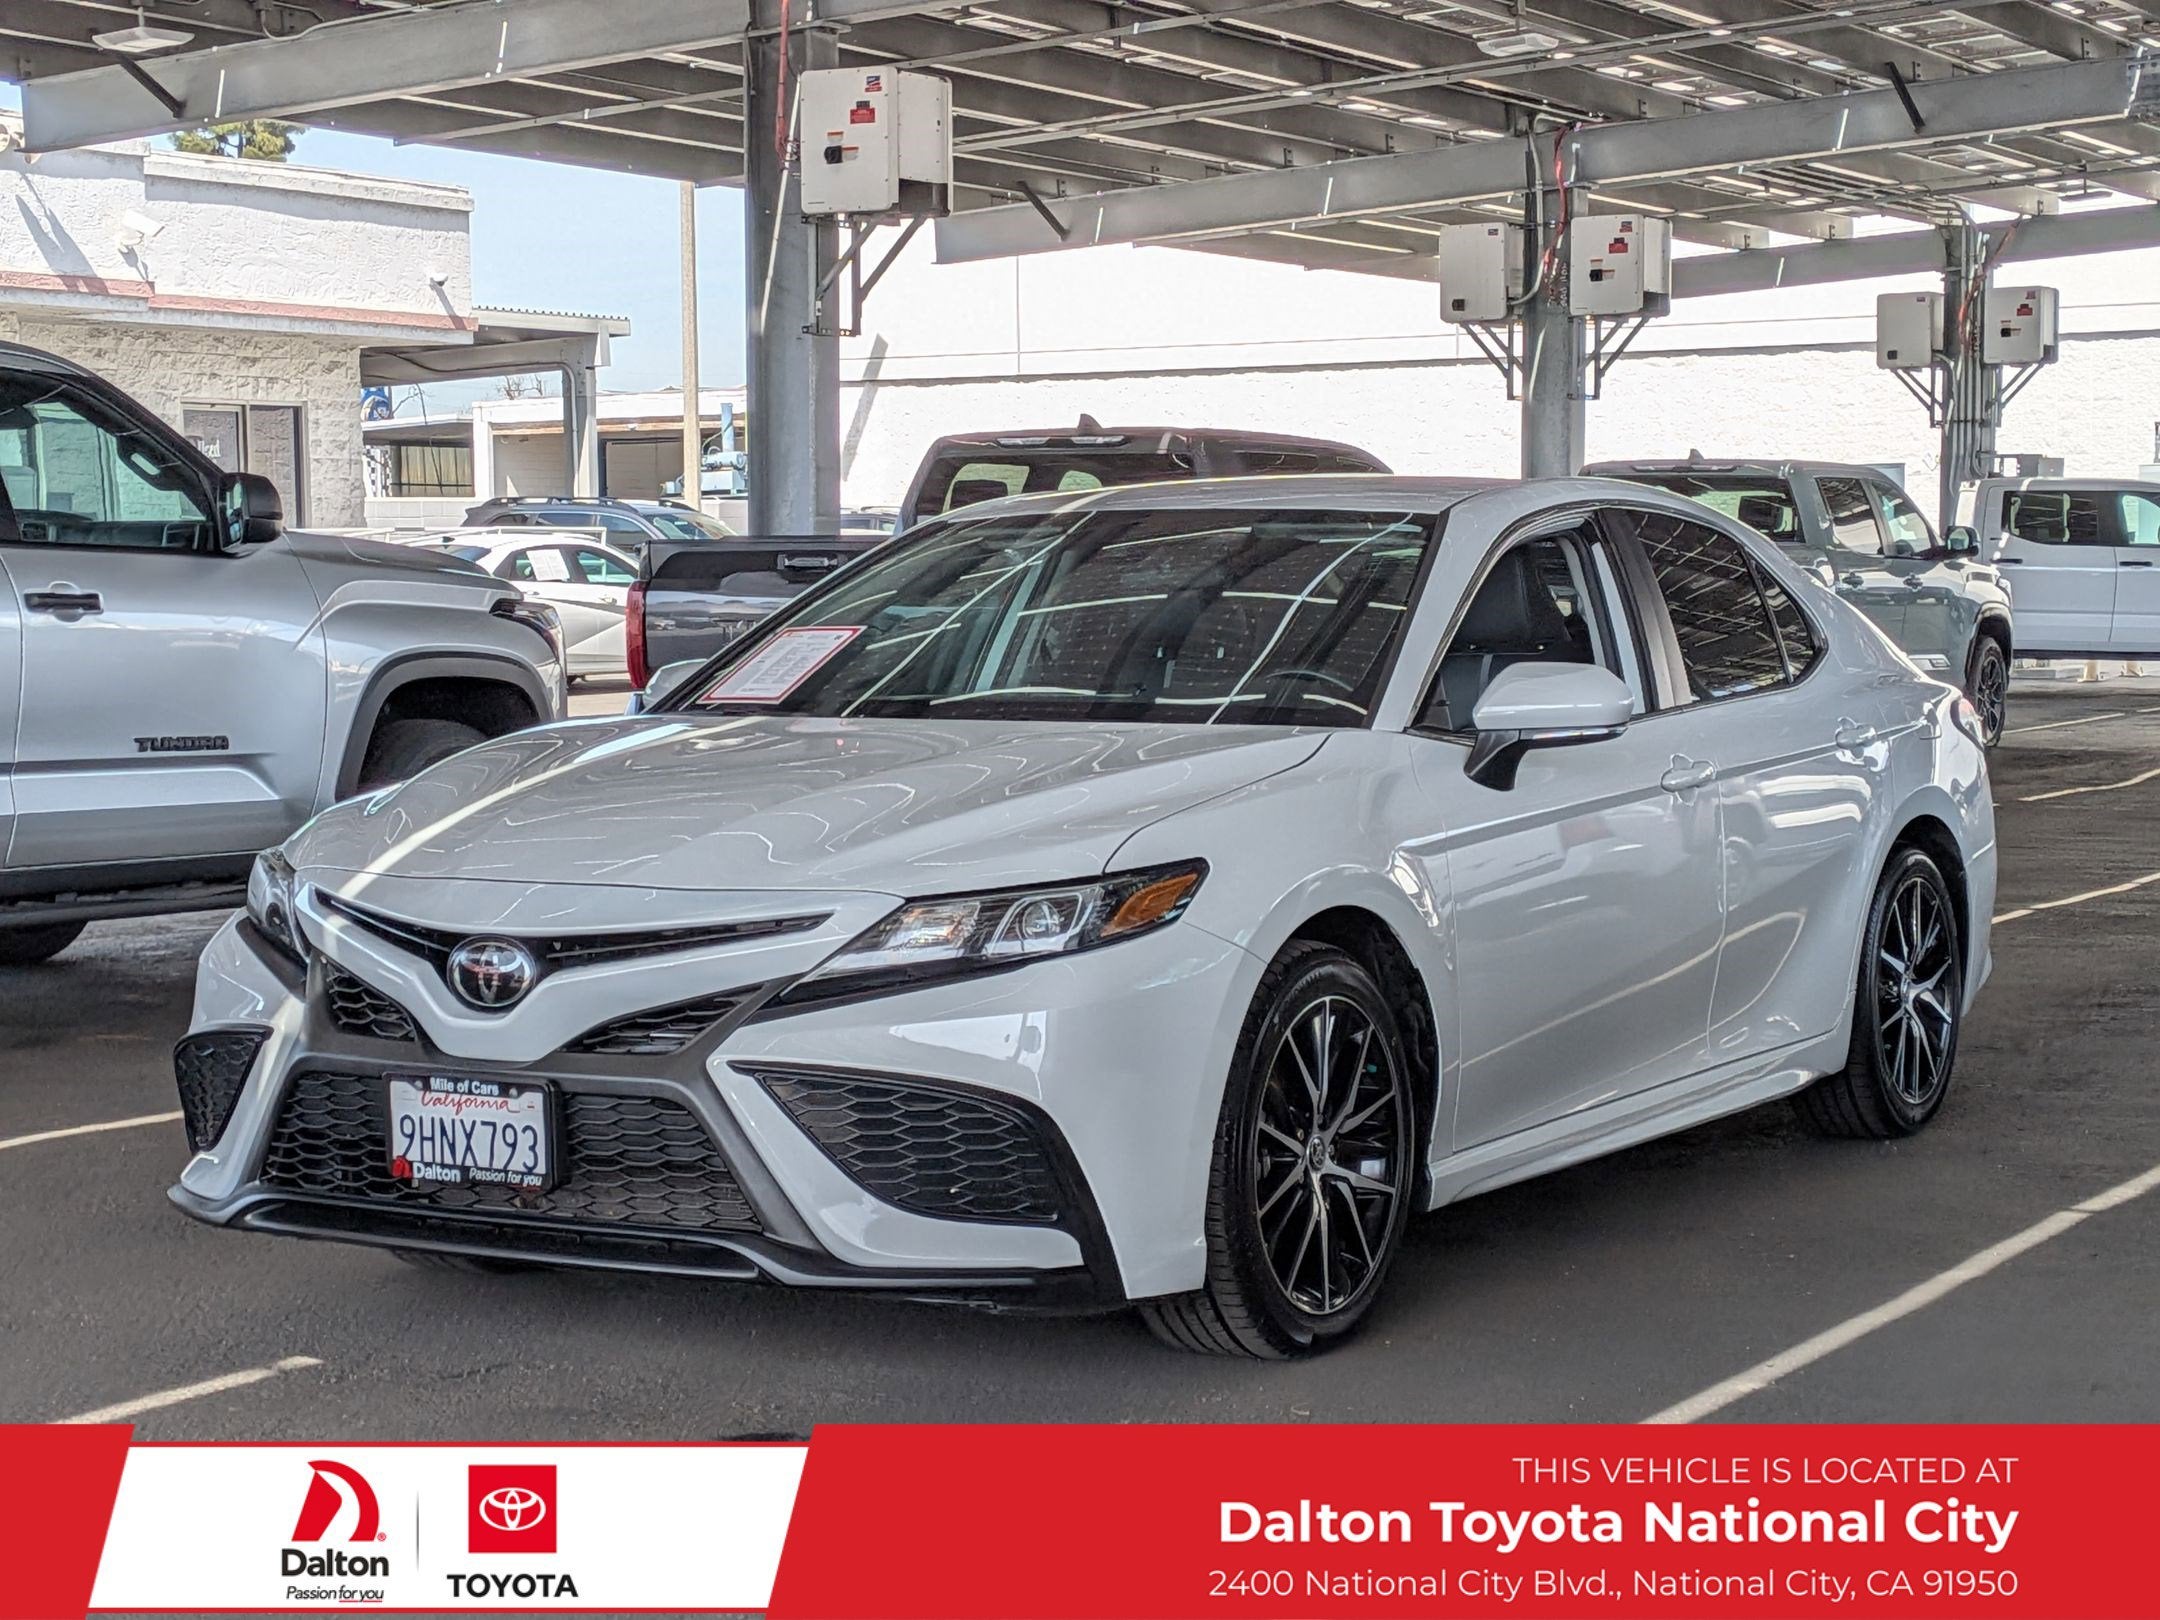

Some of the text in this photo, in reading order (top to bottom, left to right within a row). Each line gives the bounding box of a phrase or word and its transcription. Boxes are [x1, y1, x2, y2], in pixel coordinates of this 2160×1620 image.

[134, 736, 229, 752] TUNDRA
[430, 1077, 500, 1096] Mile of Cars
[421, 1089, 520, 1116] California
[400, 1114, 539, 1174] 9HNX793
[412, 1162, 543, 1187] Dalton Passion for you
